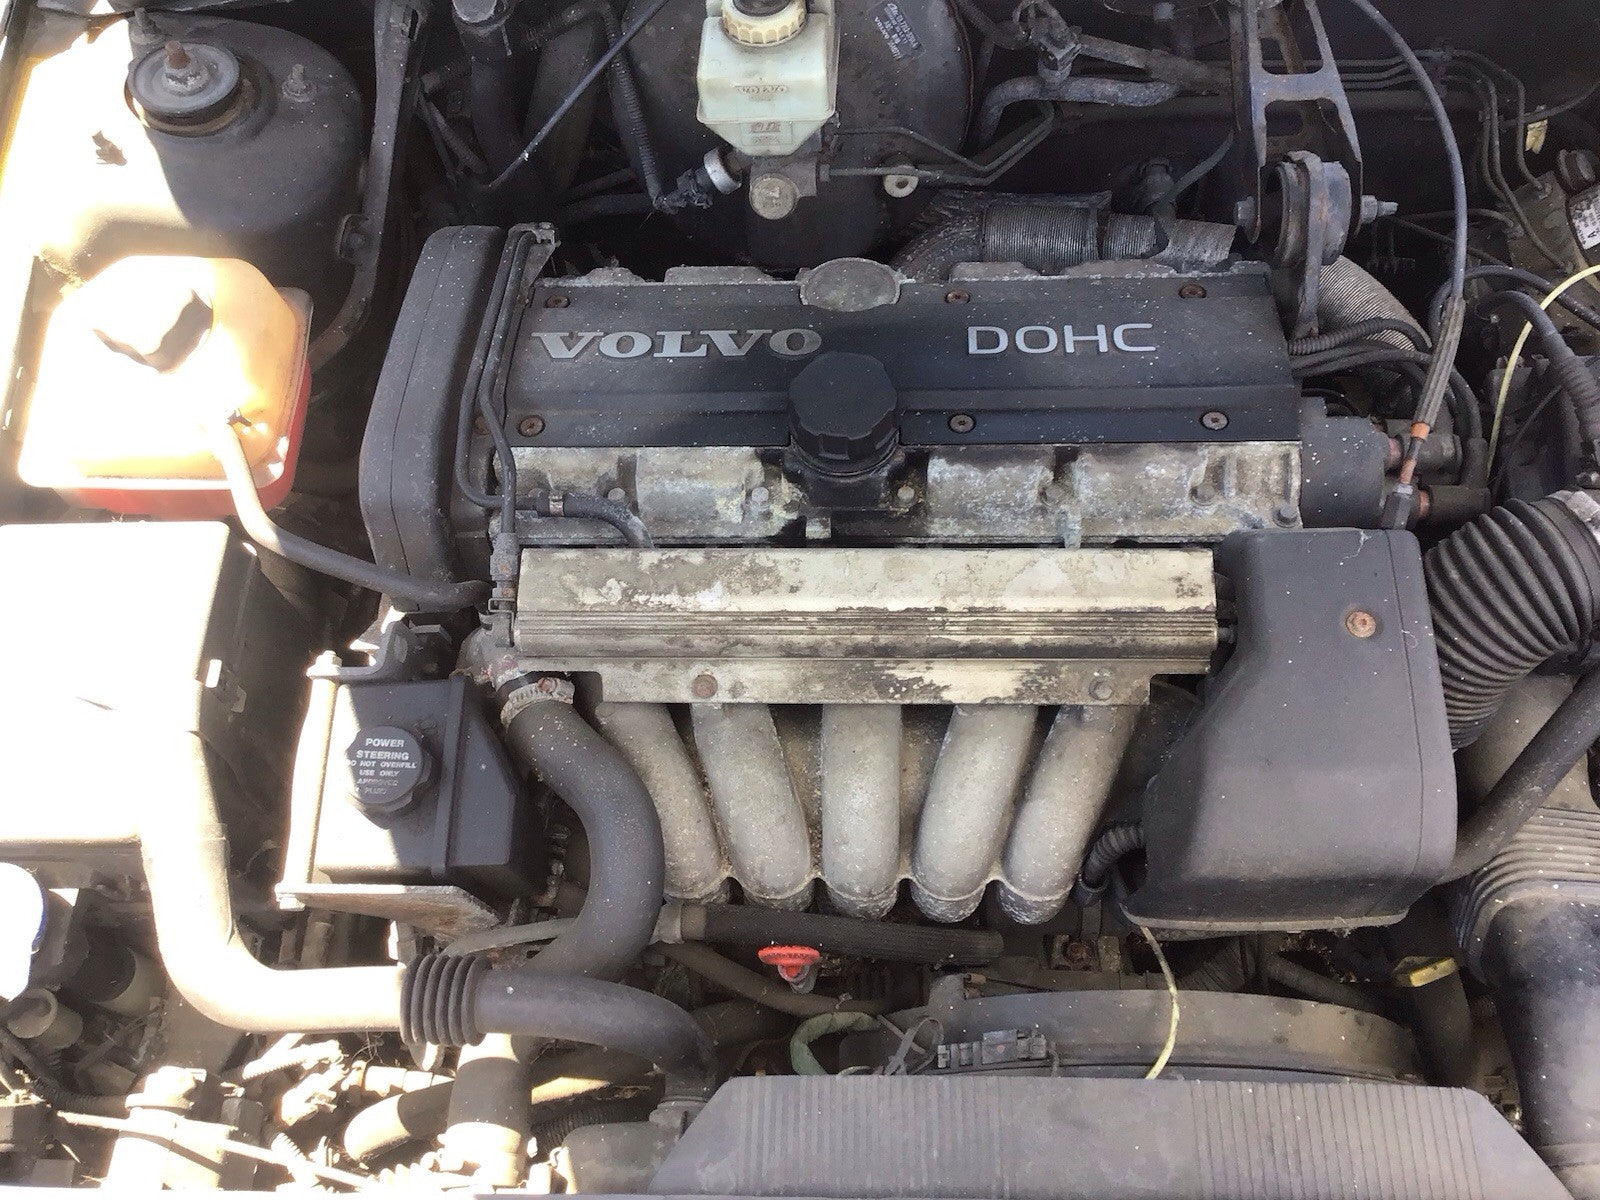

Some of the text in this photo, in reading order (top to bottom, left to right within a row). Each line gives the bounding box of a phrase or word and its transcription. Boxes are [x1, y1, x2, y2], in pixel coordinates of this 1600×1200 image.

[531, 328, 822, 359] VOLVO
[967, 323, 1156, 355] DOHC
[365, 737, 405, 748] POWER
[356, 749, 410, 760] STEERING
[380, 761, 417, 769] OVERFILL
